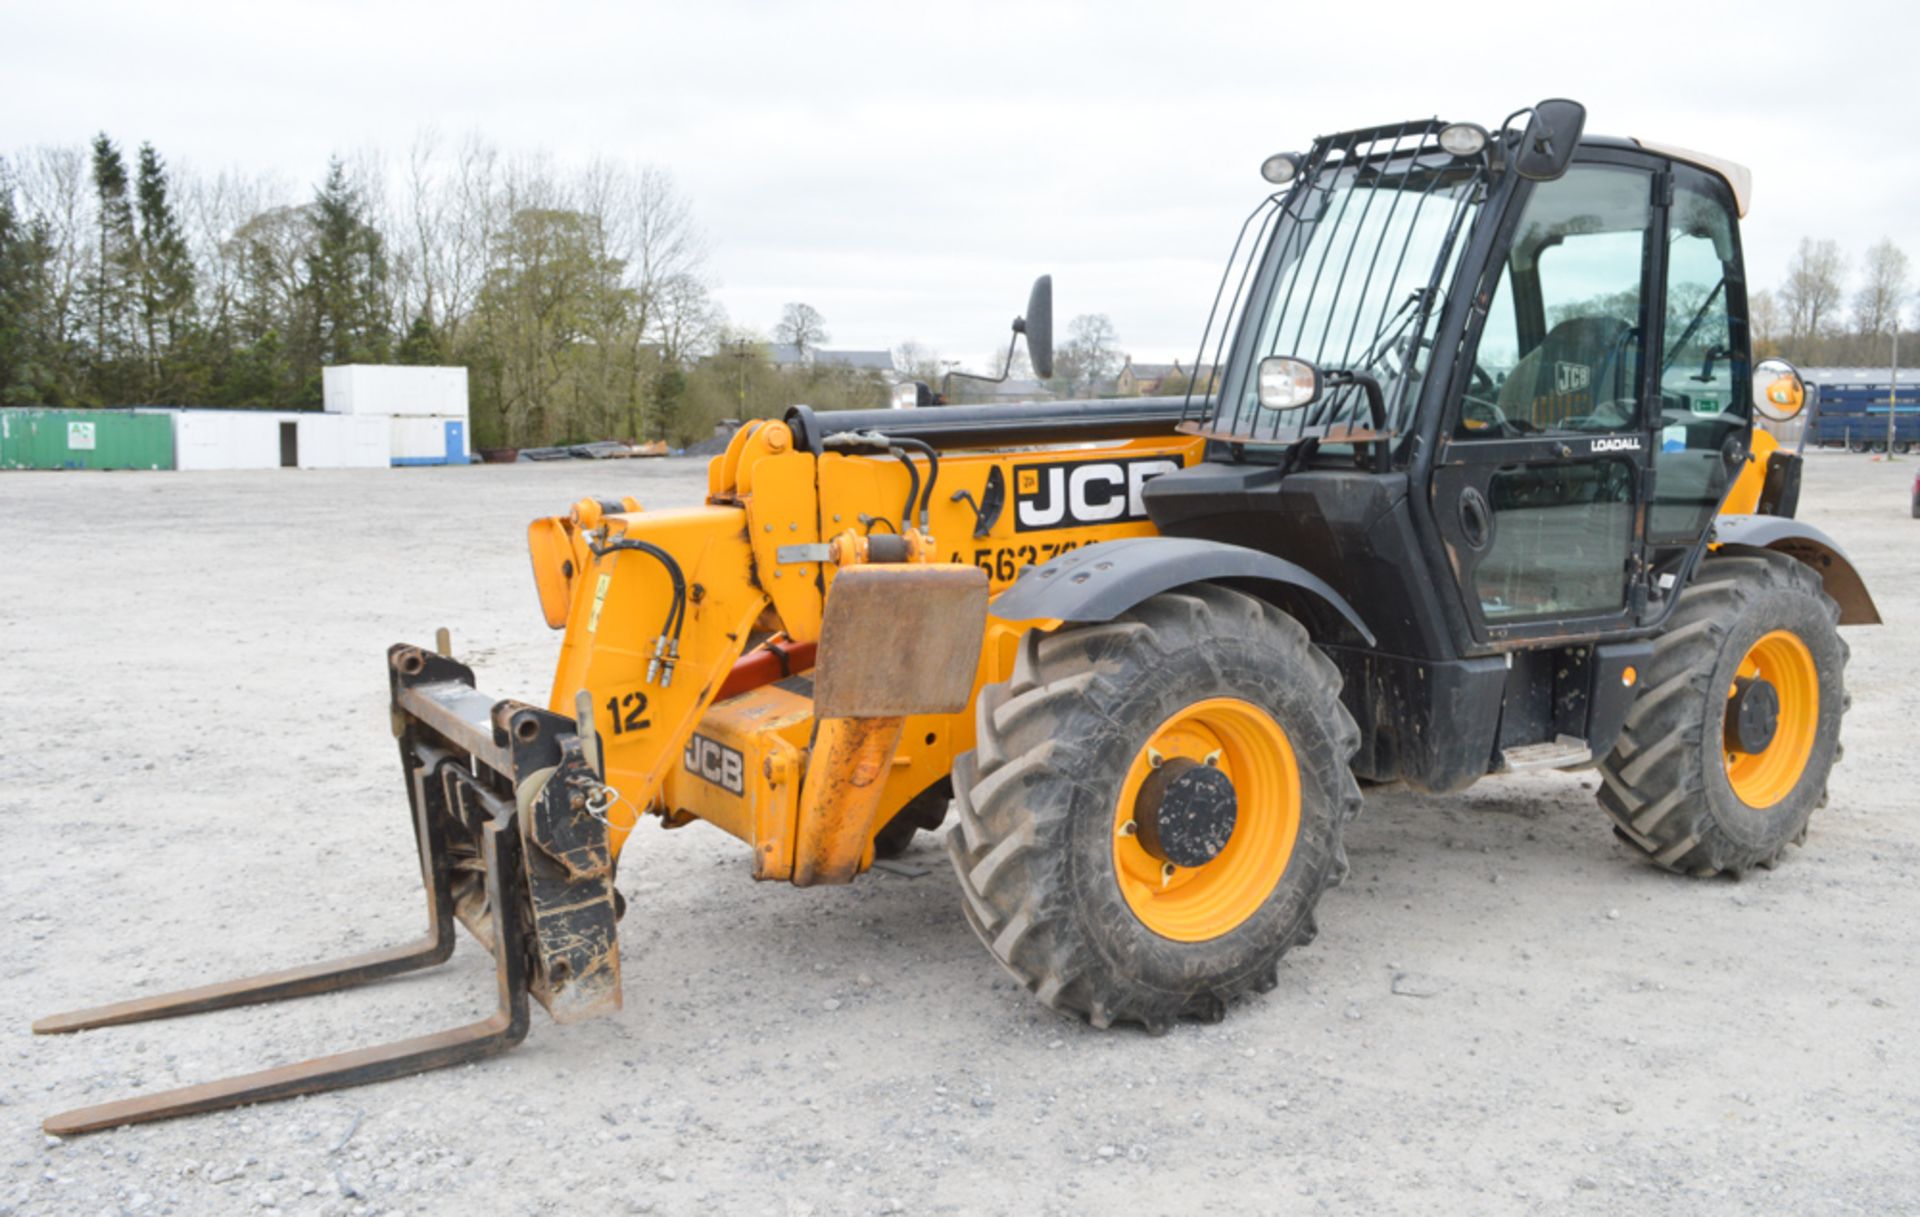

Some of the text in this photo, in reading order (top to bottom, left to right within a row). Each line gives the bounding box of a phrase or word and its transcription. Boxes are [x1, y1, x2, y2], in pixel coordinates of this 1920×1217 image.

[1560, 366, 1587, 390] JCB
[1591, 438, 1640, 451] LOADALL
[606, 692, 651, 735] 12
[685, 735, 743, 793] JCB
